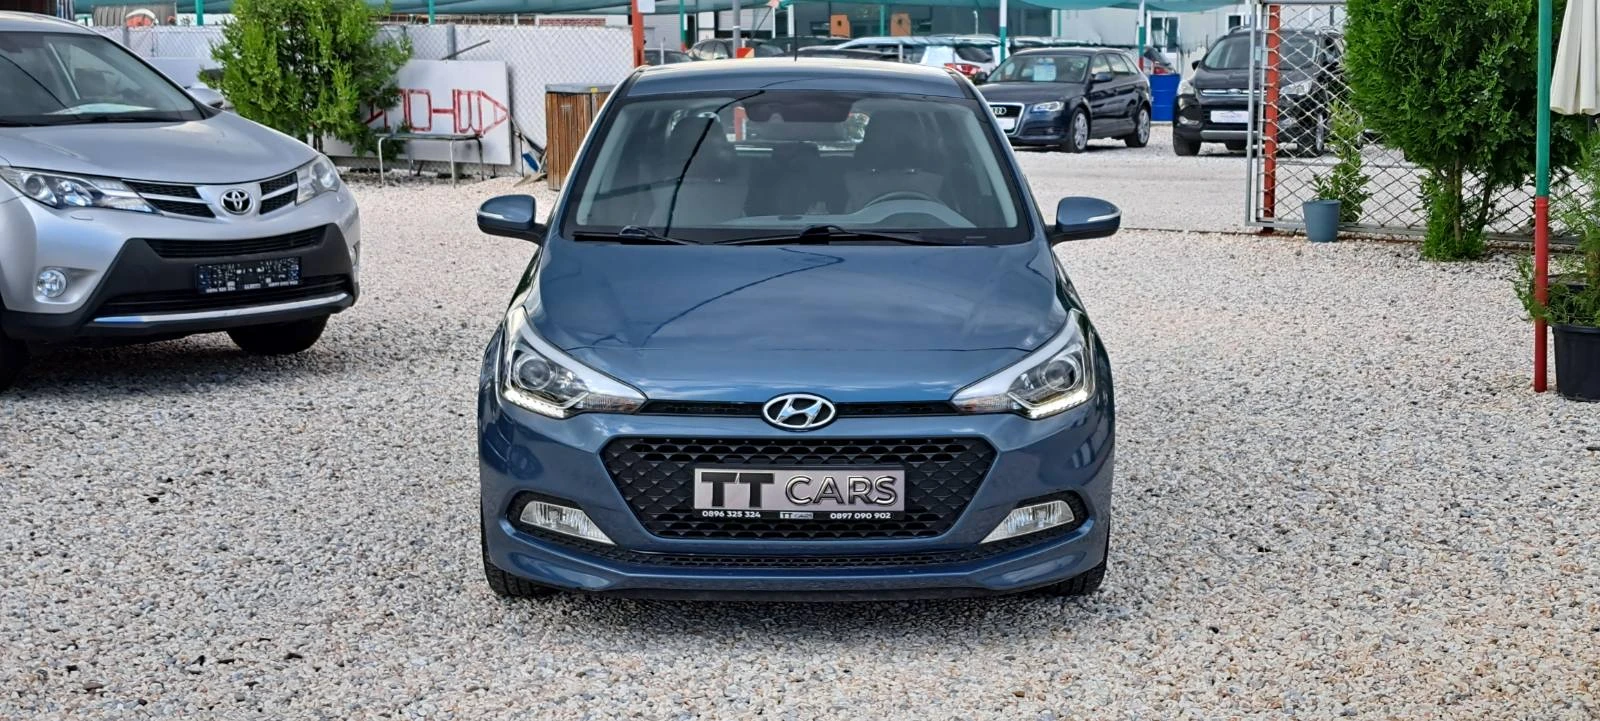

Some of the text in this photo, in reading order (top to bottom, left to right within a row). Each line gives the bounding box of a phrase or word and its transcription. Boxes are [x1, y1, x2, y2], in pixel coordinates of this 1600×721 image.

[701, 471, 898, 508] TT CARS
[702, 510, 761, 519] 0896 325 324
[830, 512, 892, 520] 0897 090 902
